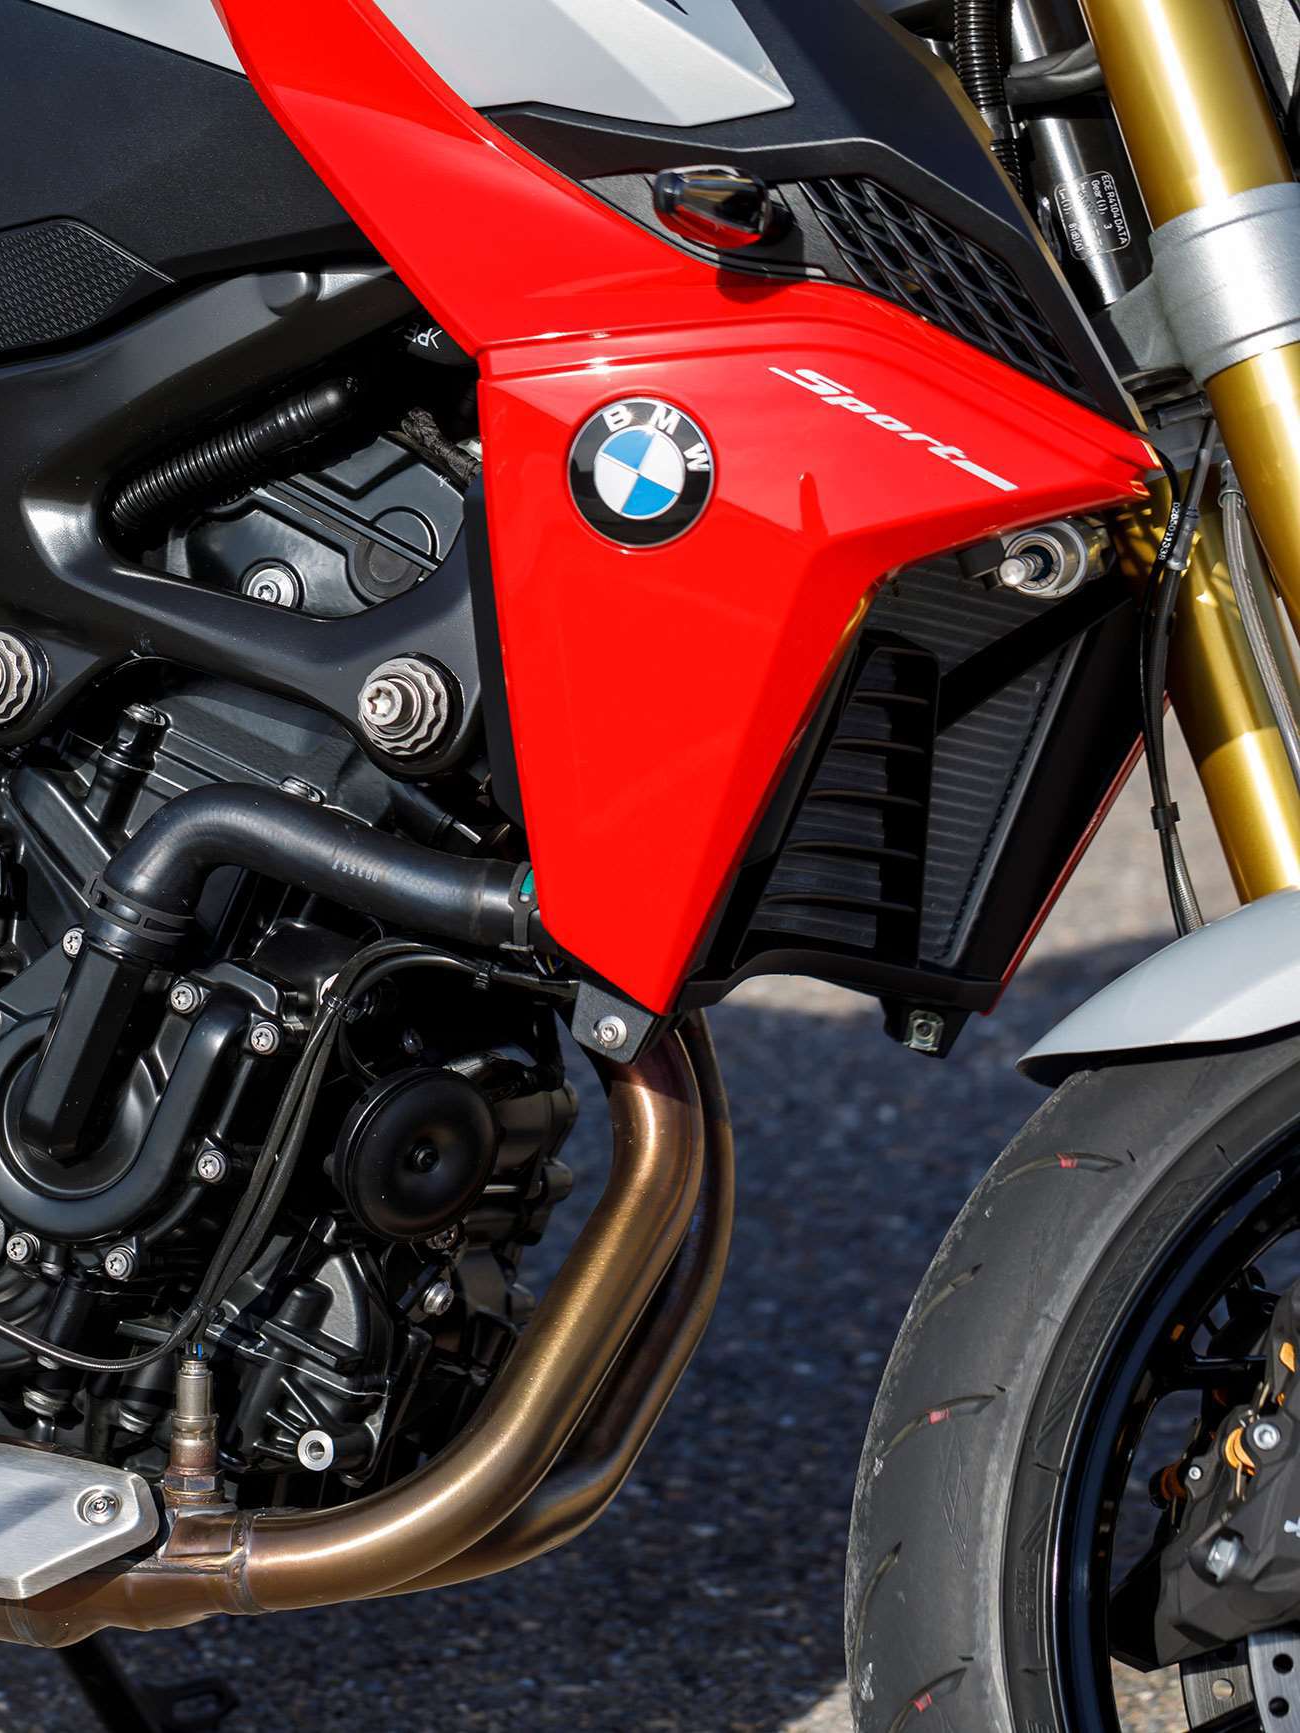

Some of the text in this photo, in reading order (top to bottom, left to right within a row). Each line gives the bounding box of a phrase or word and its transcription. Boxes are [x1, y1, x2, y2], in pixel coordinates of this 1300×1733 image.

[1101, 175, 1113, 191] ECE
[1113, 218, 1128, 244] DATA
[602, 404, 710, 472] BMW
[768, 367, 1019, 491] Sport
